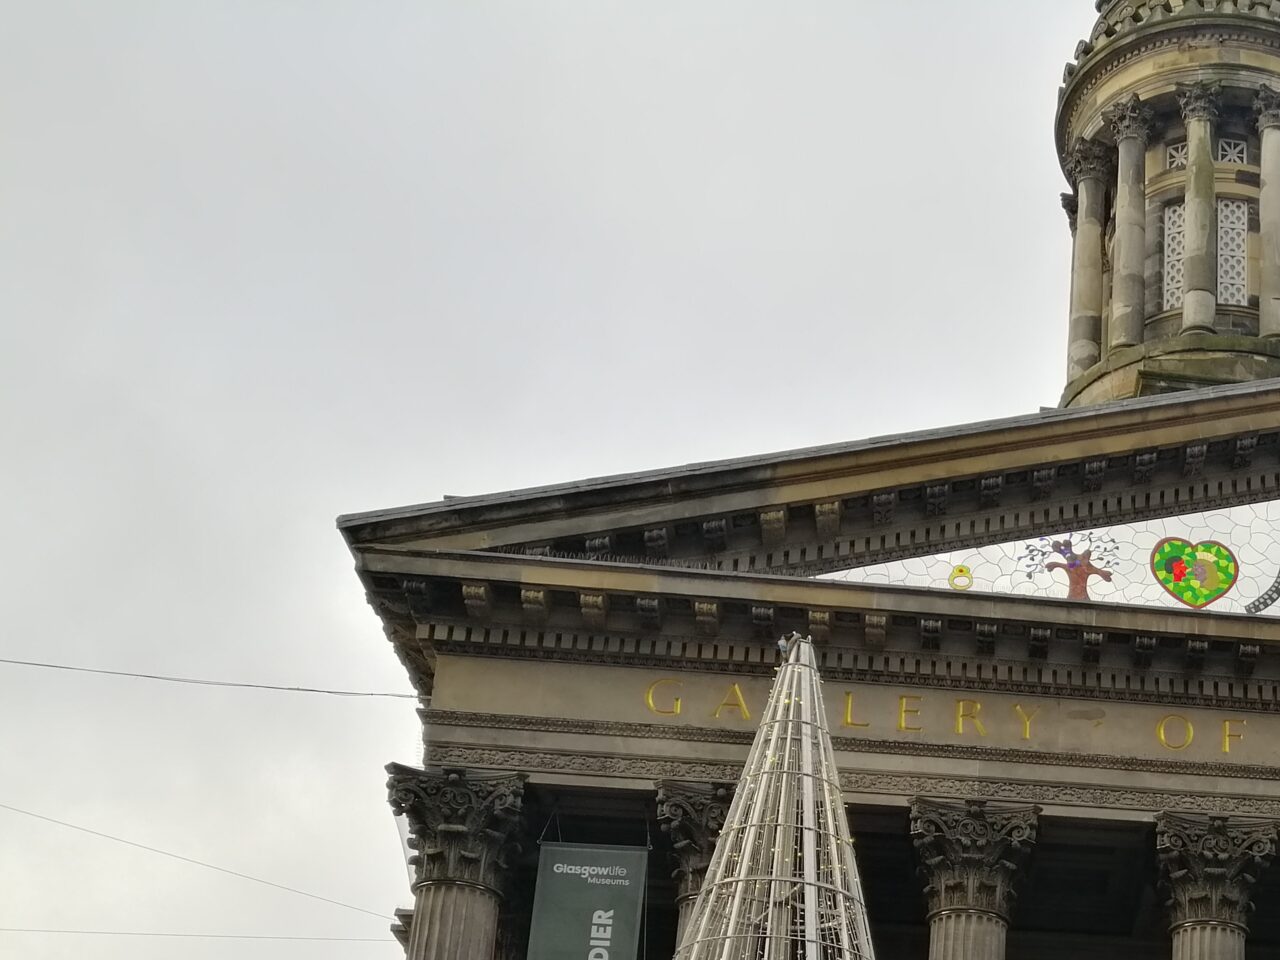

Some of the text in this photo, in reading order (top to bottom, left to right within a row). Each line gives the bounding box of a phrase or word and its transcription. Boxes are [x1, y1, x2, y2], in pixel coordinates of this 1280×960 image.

[644, 677, 1041, 742] GALERY
[1154, 713, 1247, 754] OF
[587, 876, 630, 886] Museums
